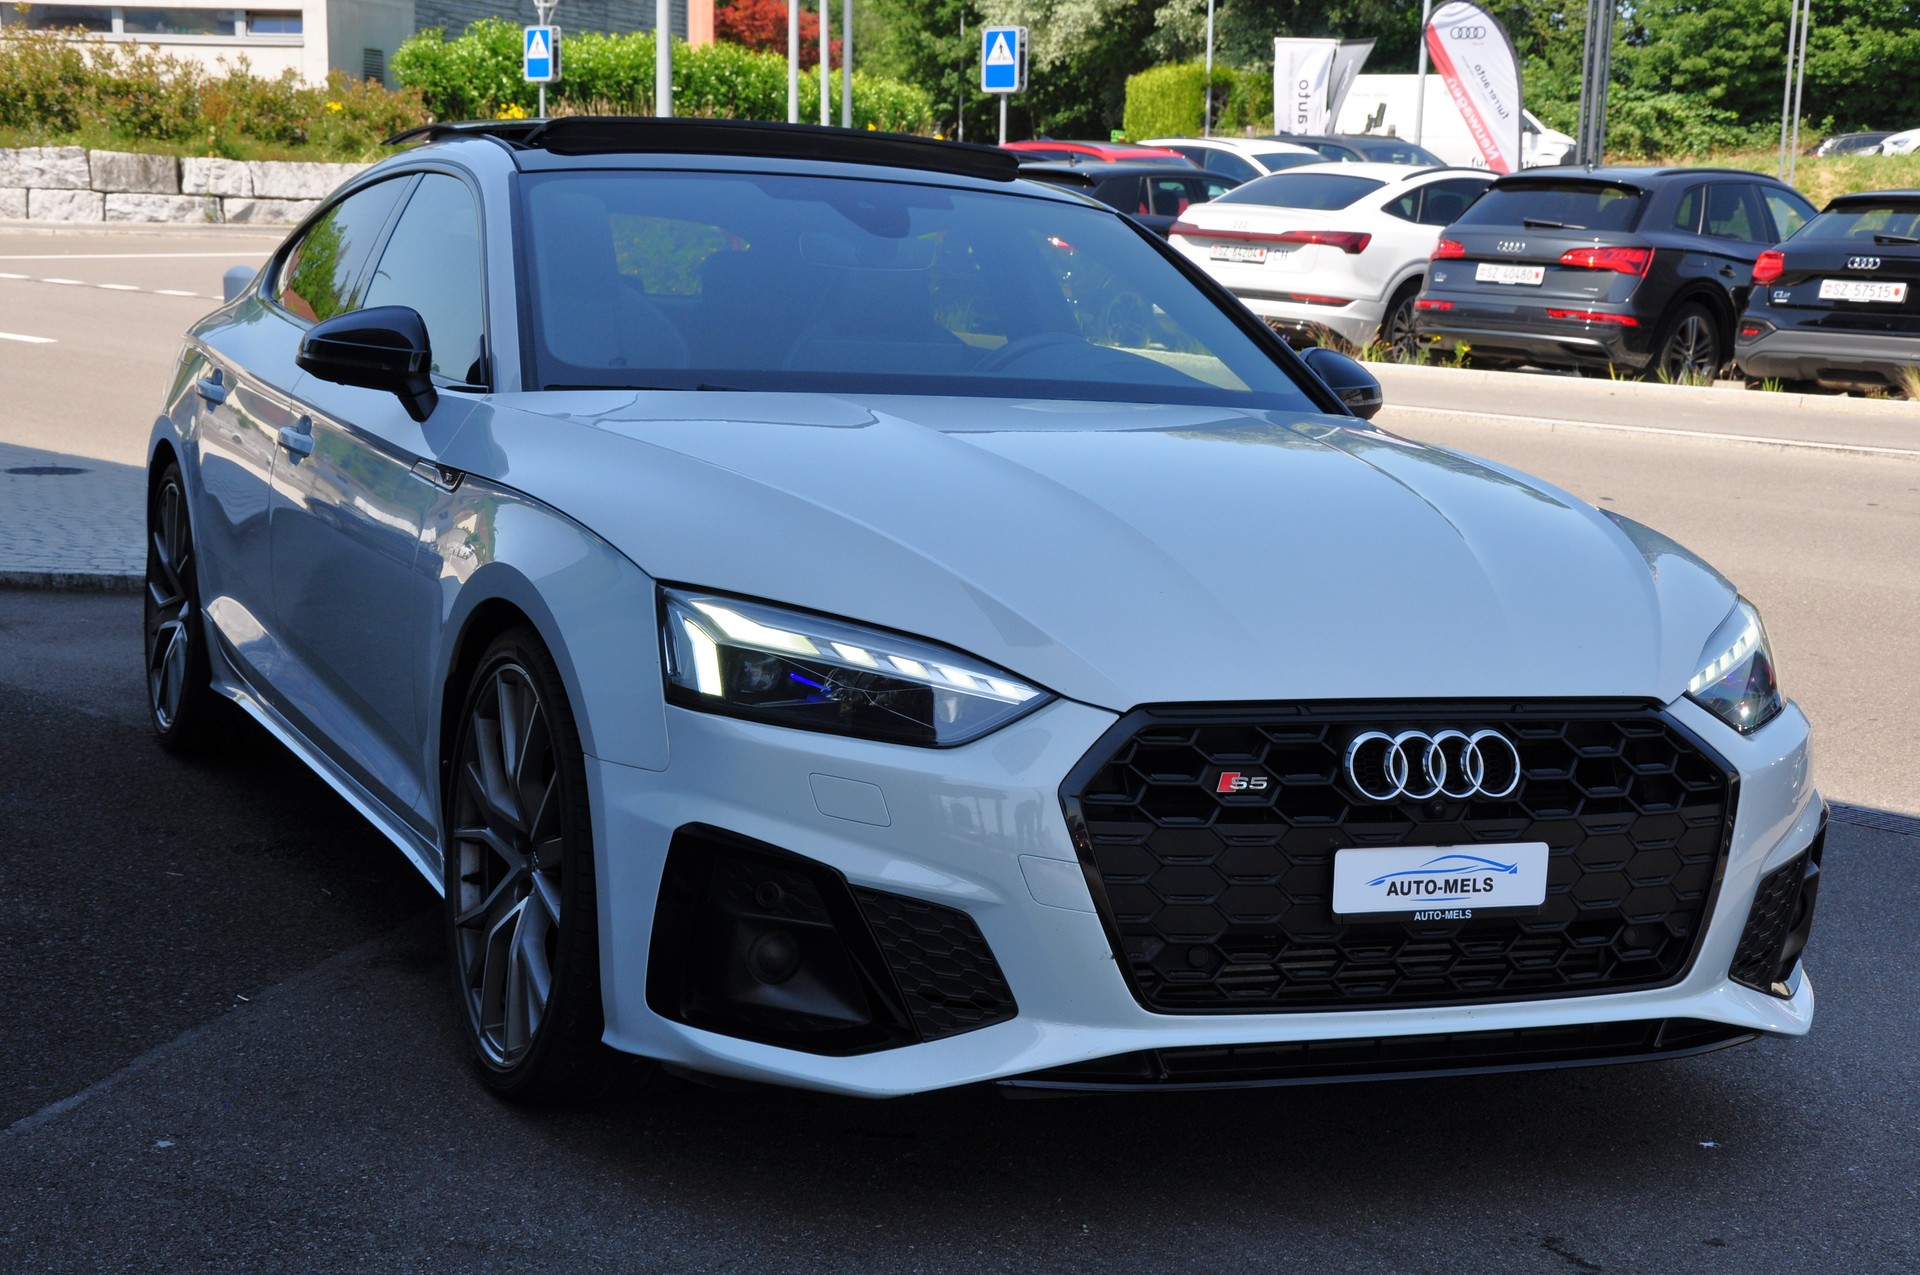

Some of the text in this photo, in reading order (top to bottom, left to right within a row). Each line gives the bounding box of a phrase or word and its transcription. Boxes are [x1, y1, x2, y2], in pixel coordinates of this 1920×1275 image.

[1486, 267, 1533, 281] SZ 40480
[1832, 283, 1892, 298] SZ 57515
[1229, 776, 1268, 790] S5
[1386, 877, 1494, 897] AUTO-MELS
[1414, 909, 1472, 921] AUTO-MELS
